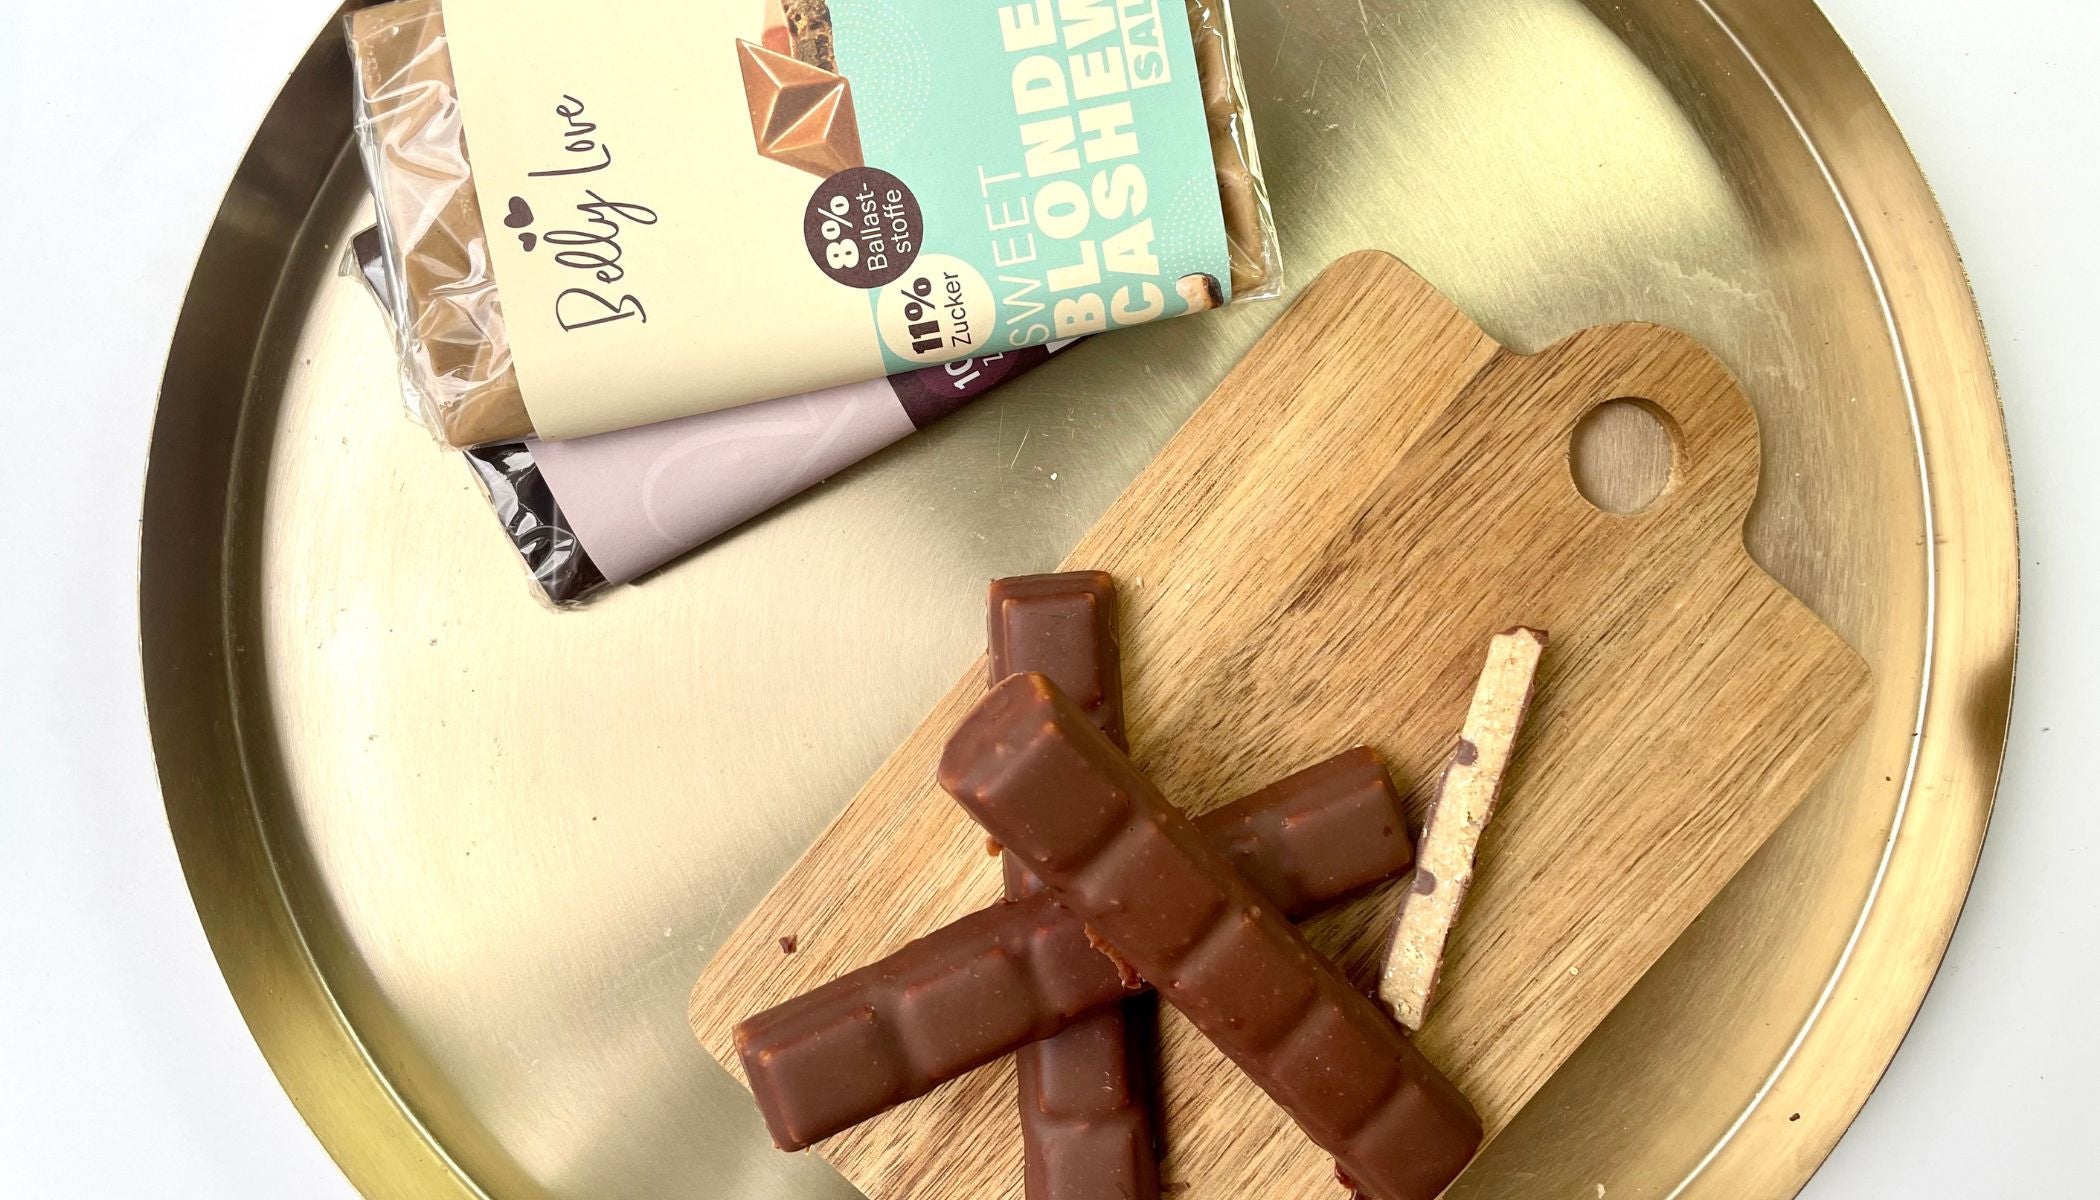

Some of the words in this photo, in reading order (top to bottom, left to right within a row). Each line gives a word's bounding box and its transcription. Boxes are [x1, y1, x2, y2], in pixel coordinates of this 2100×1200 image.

[527, 94, 611, 177] Love
[997, 0, 1107, 338] BLONDE
[543, 189, 658, 332] Belly
[817, 195, 860, 270] 8%
[856, 182, 889, 271] Ballast-
[882, 189, 912, 254] stoffe
[977, 165, 1050, 347] SWEET
[900, 277, 944, 354] 11%
[943, 271, 972, 348] Zucker
